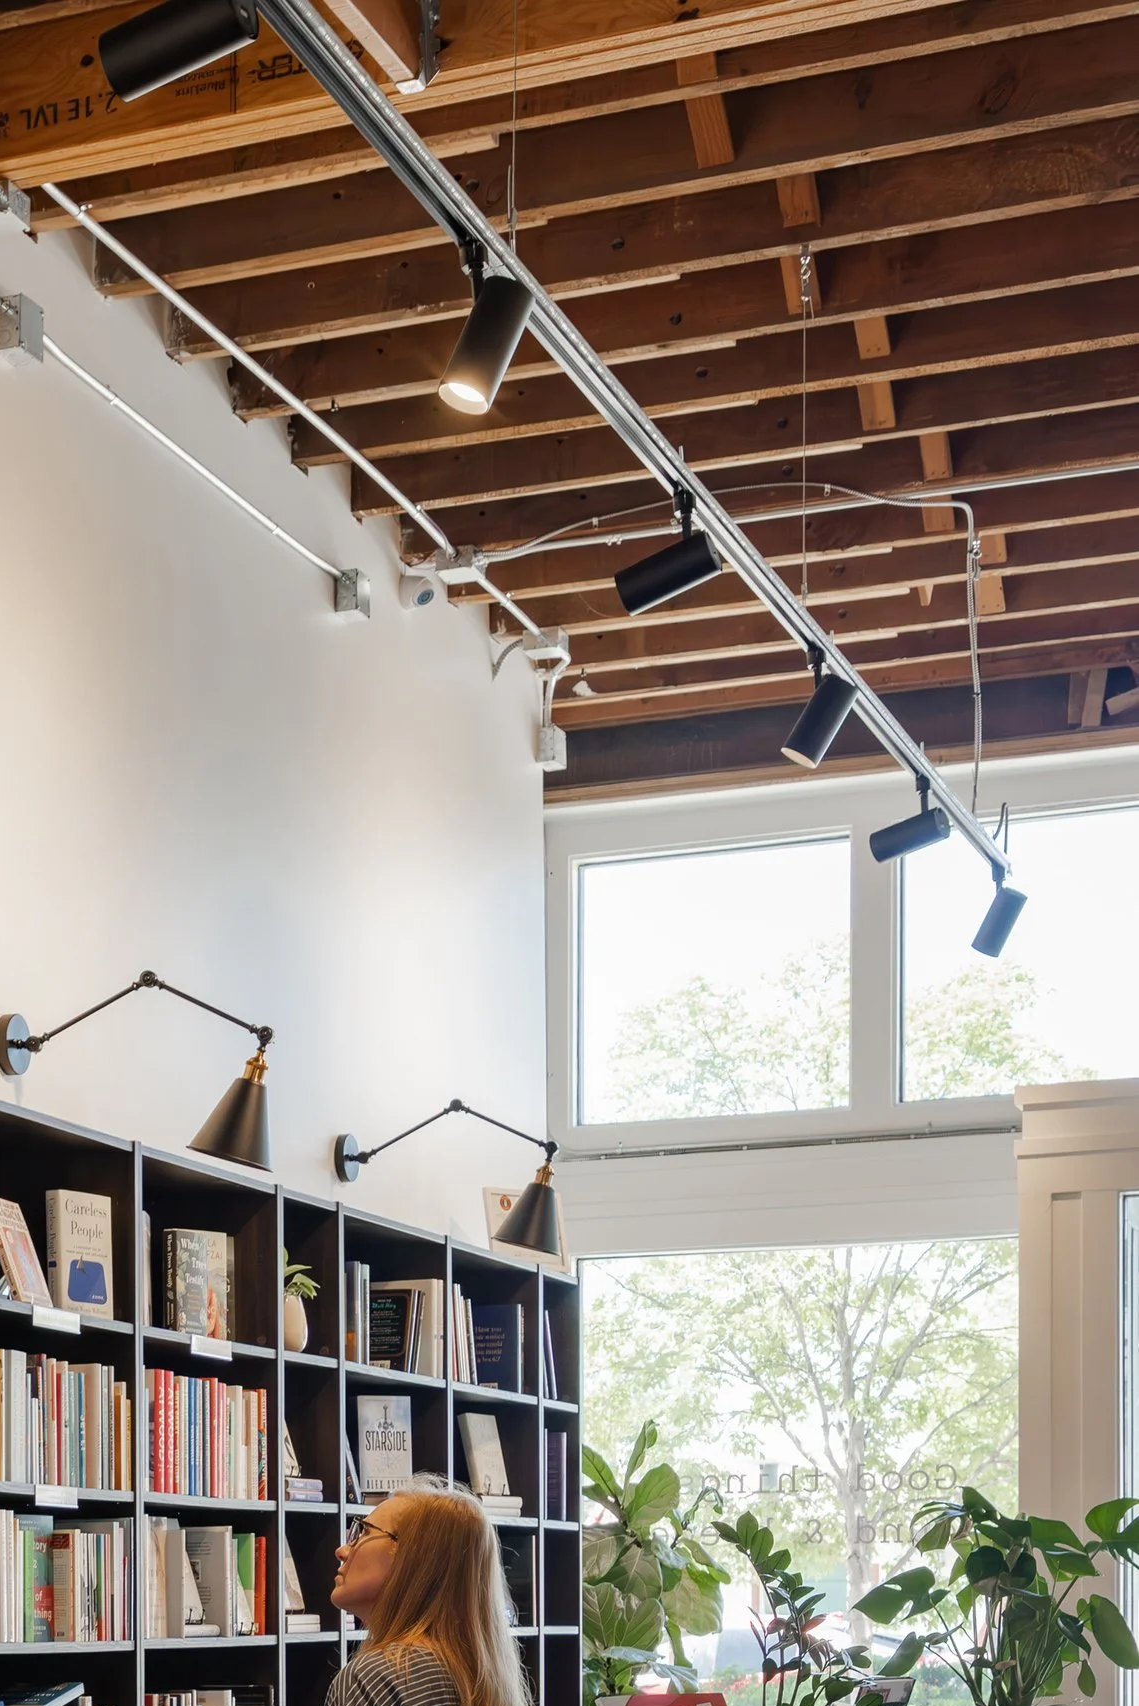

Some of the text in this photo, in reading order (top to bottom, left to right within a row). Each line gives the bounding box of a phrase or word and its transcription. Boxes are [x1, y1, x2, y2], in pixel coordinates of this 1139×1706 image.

[18, 102, 59, 130] LVL
[65, 1198, 108, 1218] Careless
[70, 1220, 105, 1245] People
[180, 1238, 201, 1252] When
[365, 1430, 407, 1451] STARSIDE
[35, 1591, 43, 1601] of
